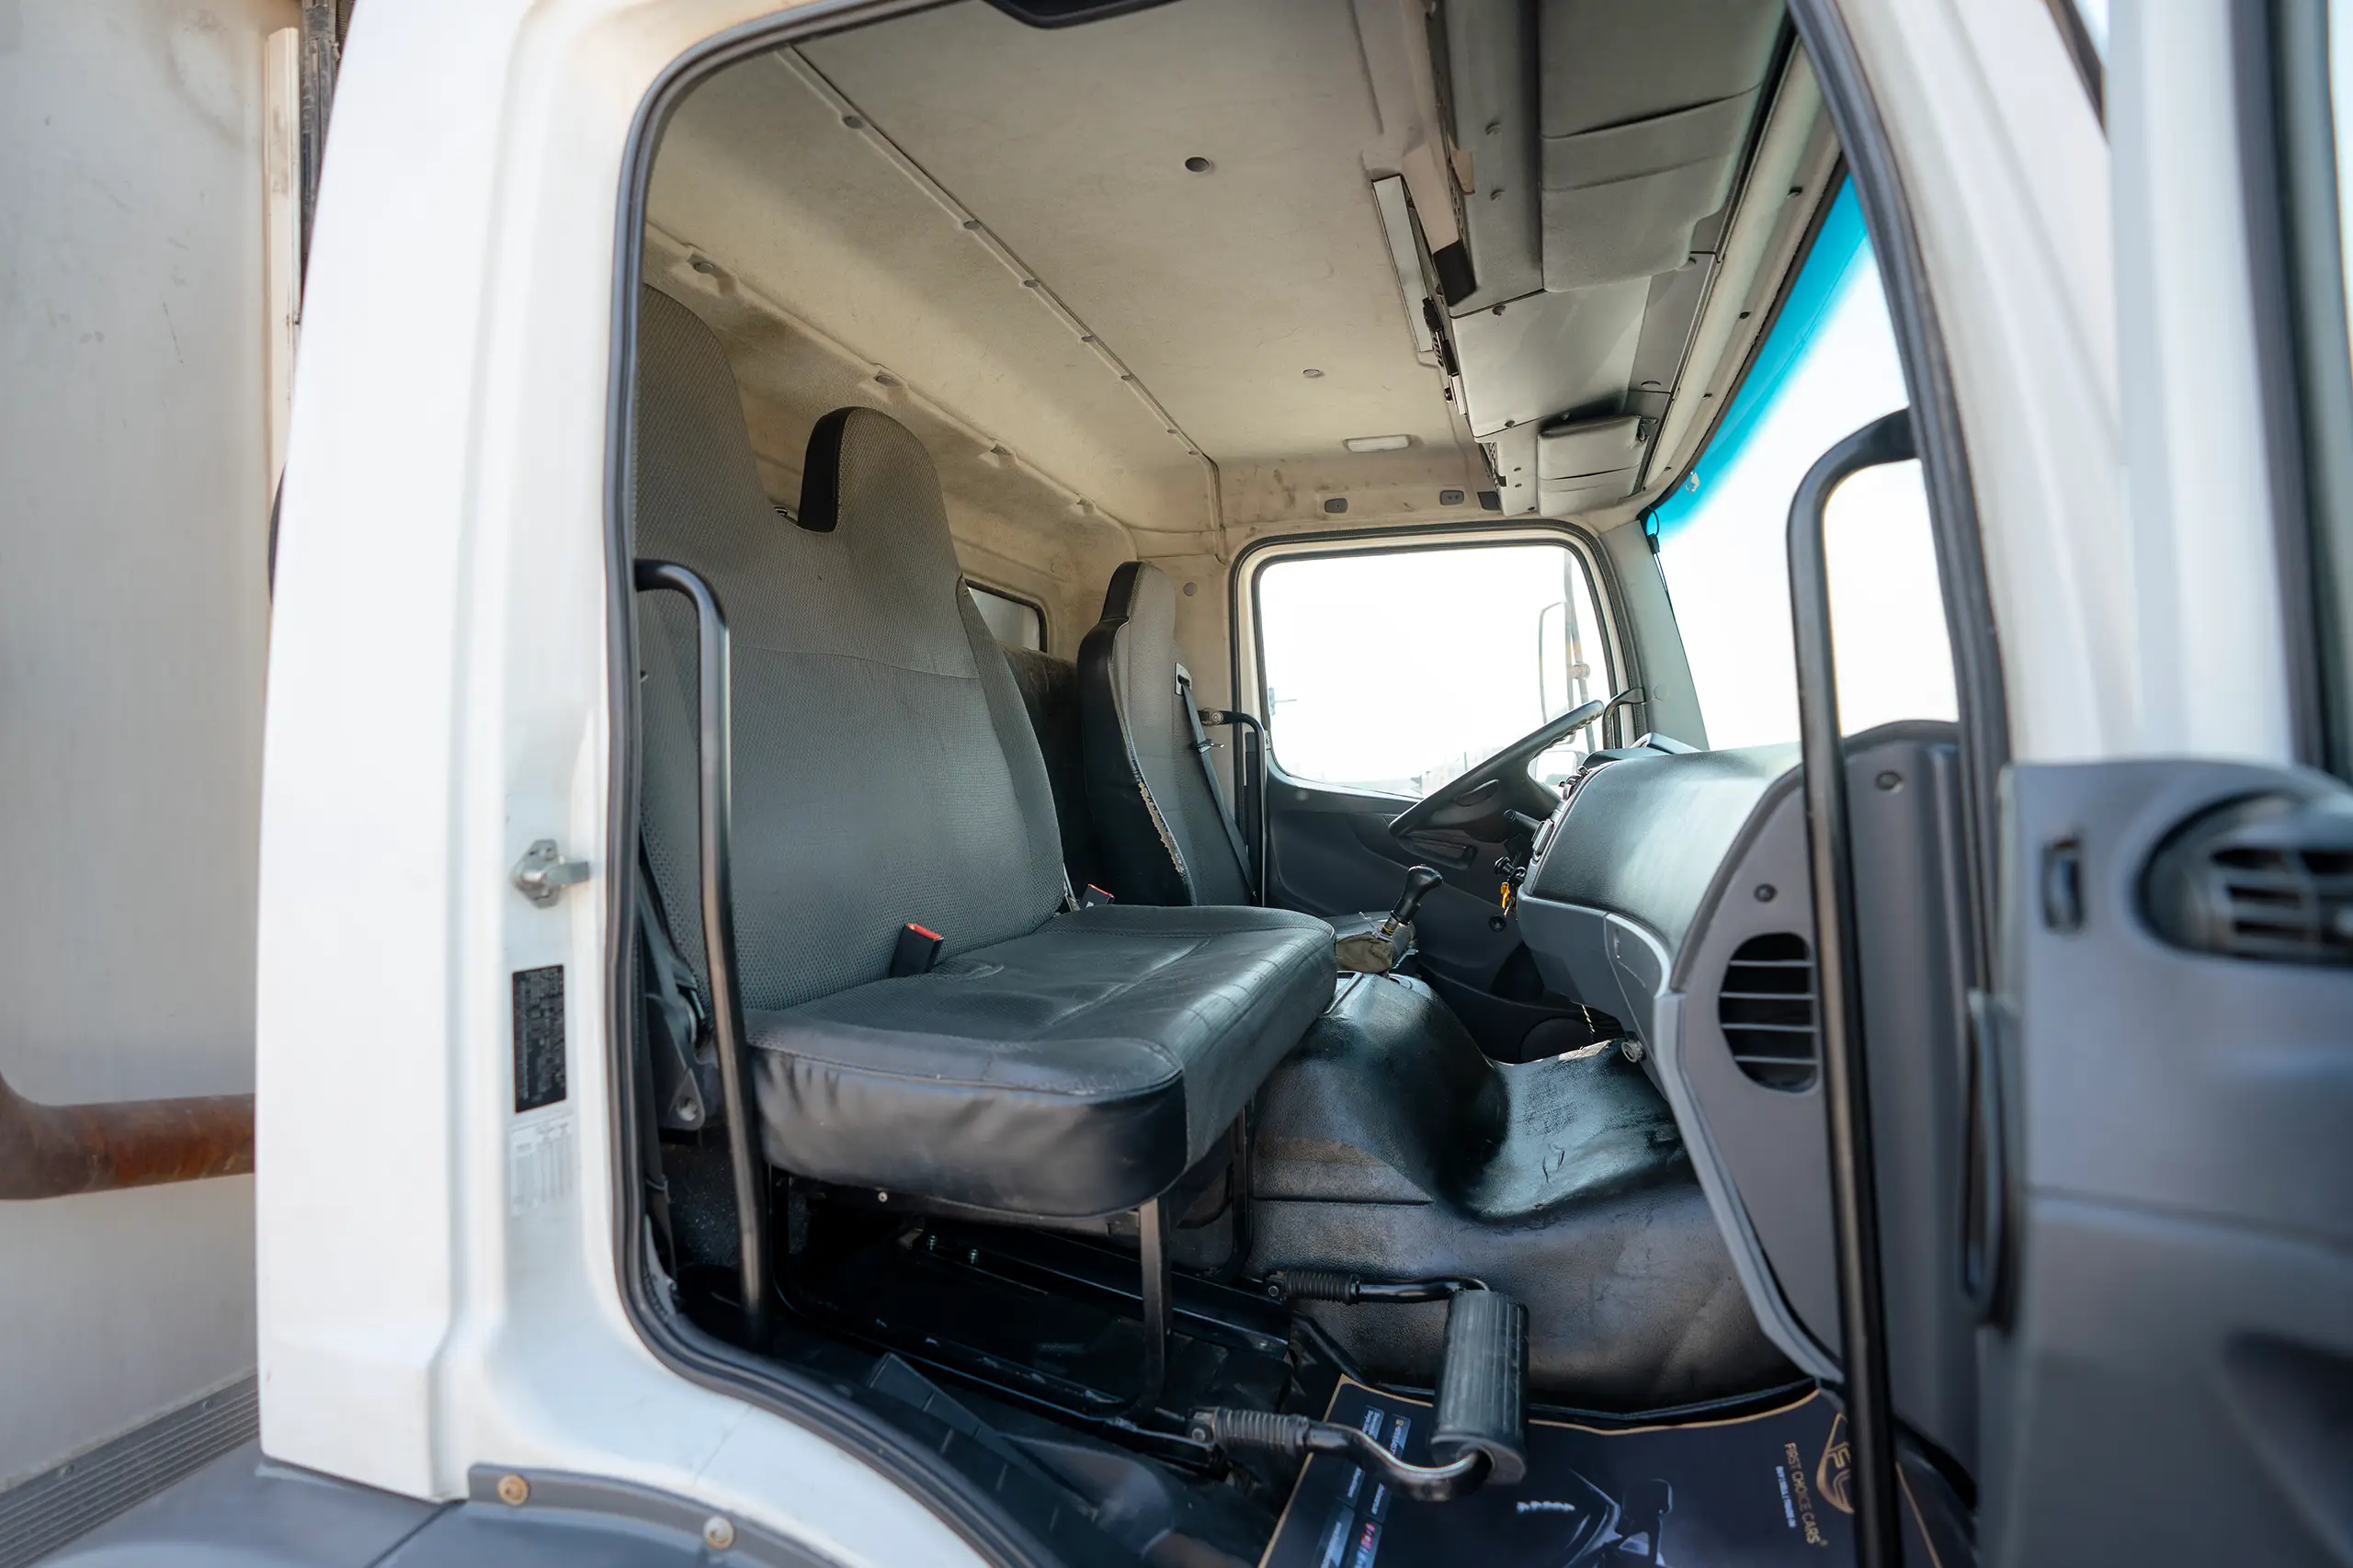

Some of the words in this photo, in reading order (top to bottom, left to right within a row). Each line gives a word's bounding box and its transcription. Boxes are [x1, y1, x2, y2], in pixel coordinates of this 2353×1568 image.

[1785, 1442, 1802, 1470] FIRST
[1792, 1471, 1813, 1512] CHOICE
[1802, 1512, 1821, 1544] CARS
